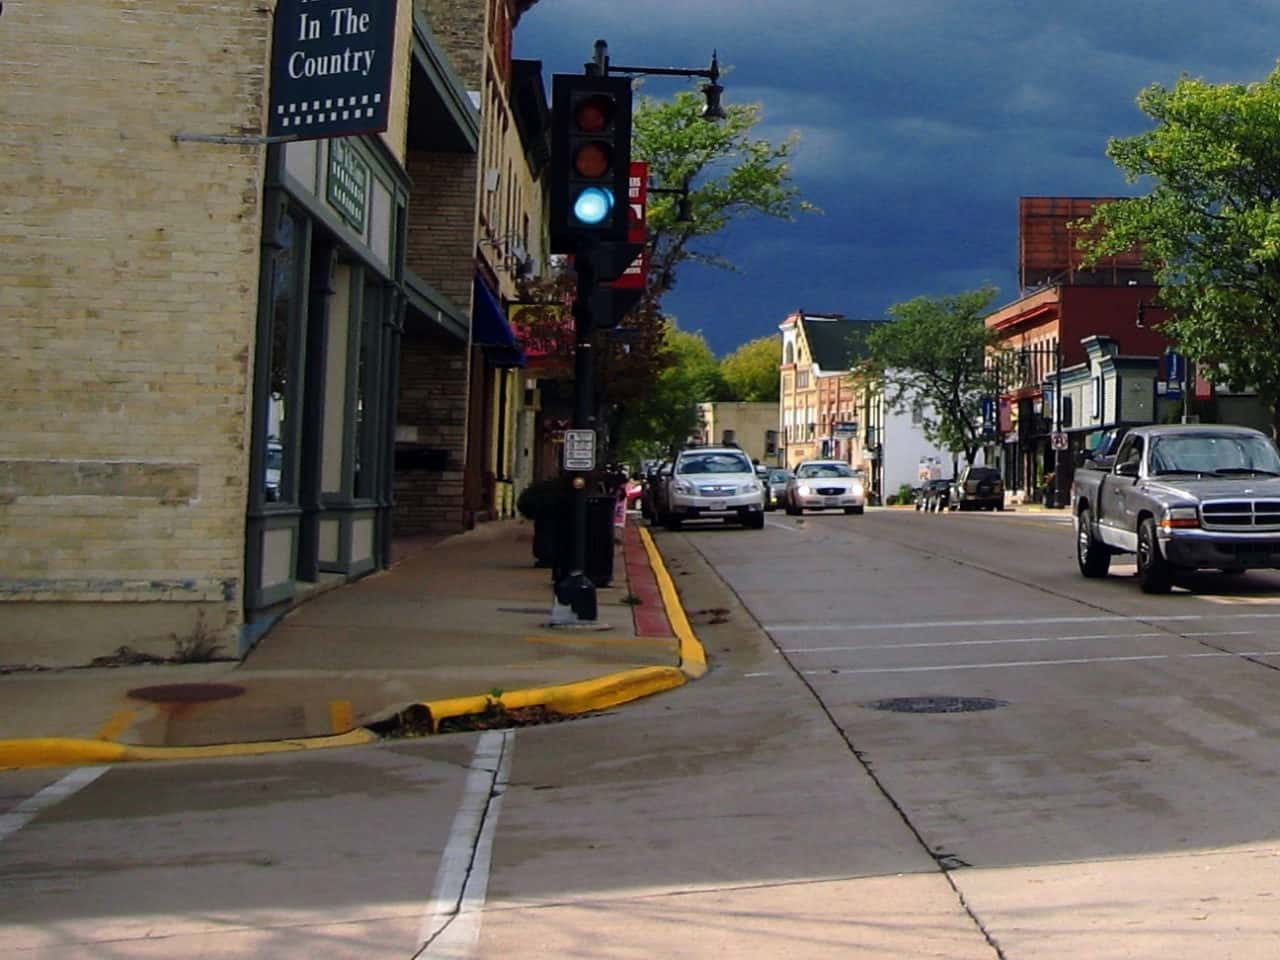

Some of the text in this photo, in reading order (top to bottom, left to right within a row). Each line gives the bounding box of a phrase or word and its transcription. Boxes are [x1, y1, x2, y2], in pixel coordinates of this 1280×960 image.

[299, 7, 370, 41] In The
[288, 47, 375, 79] Country
